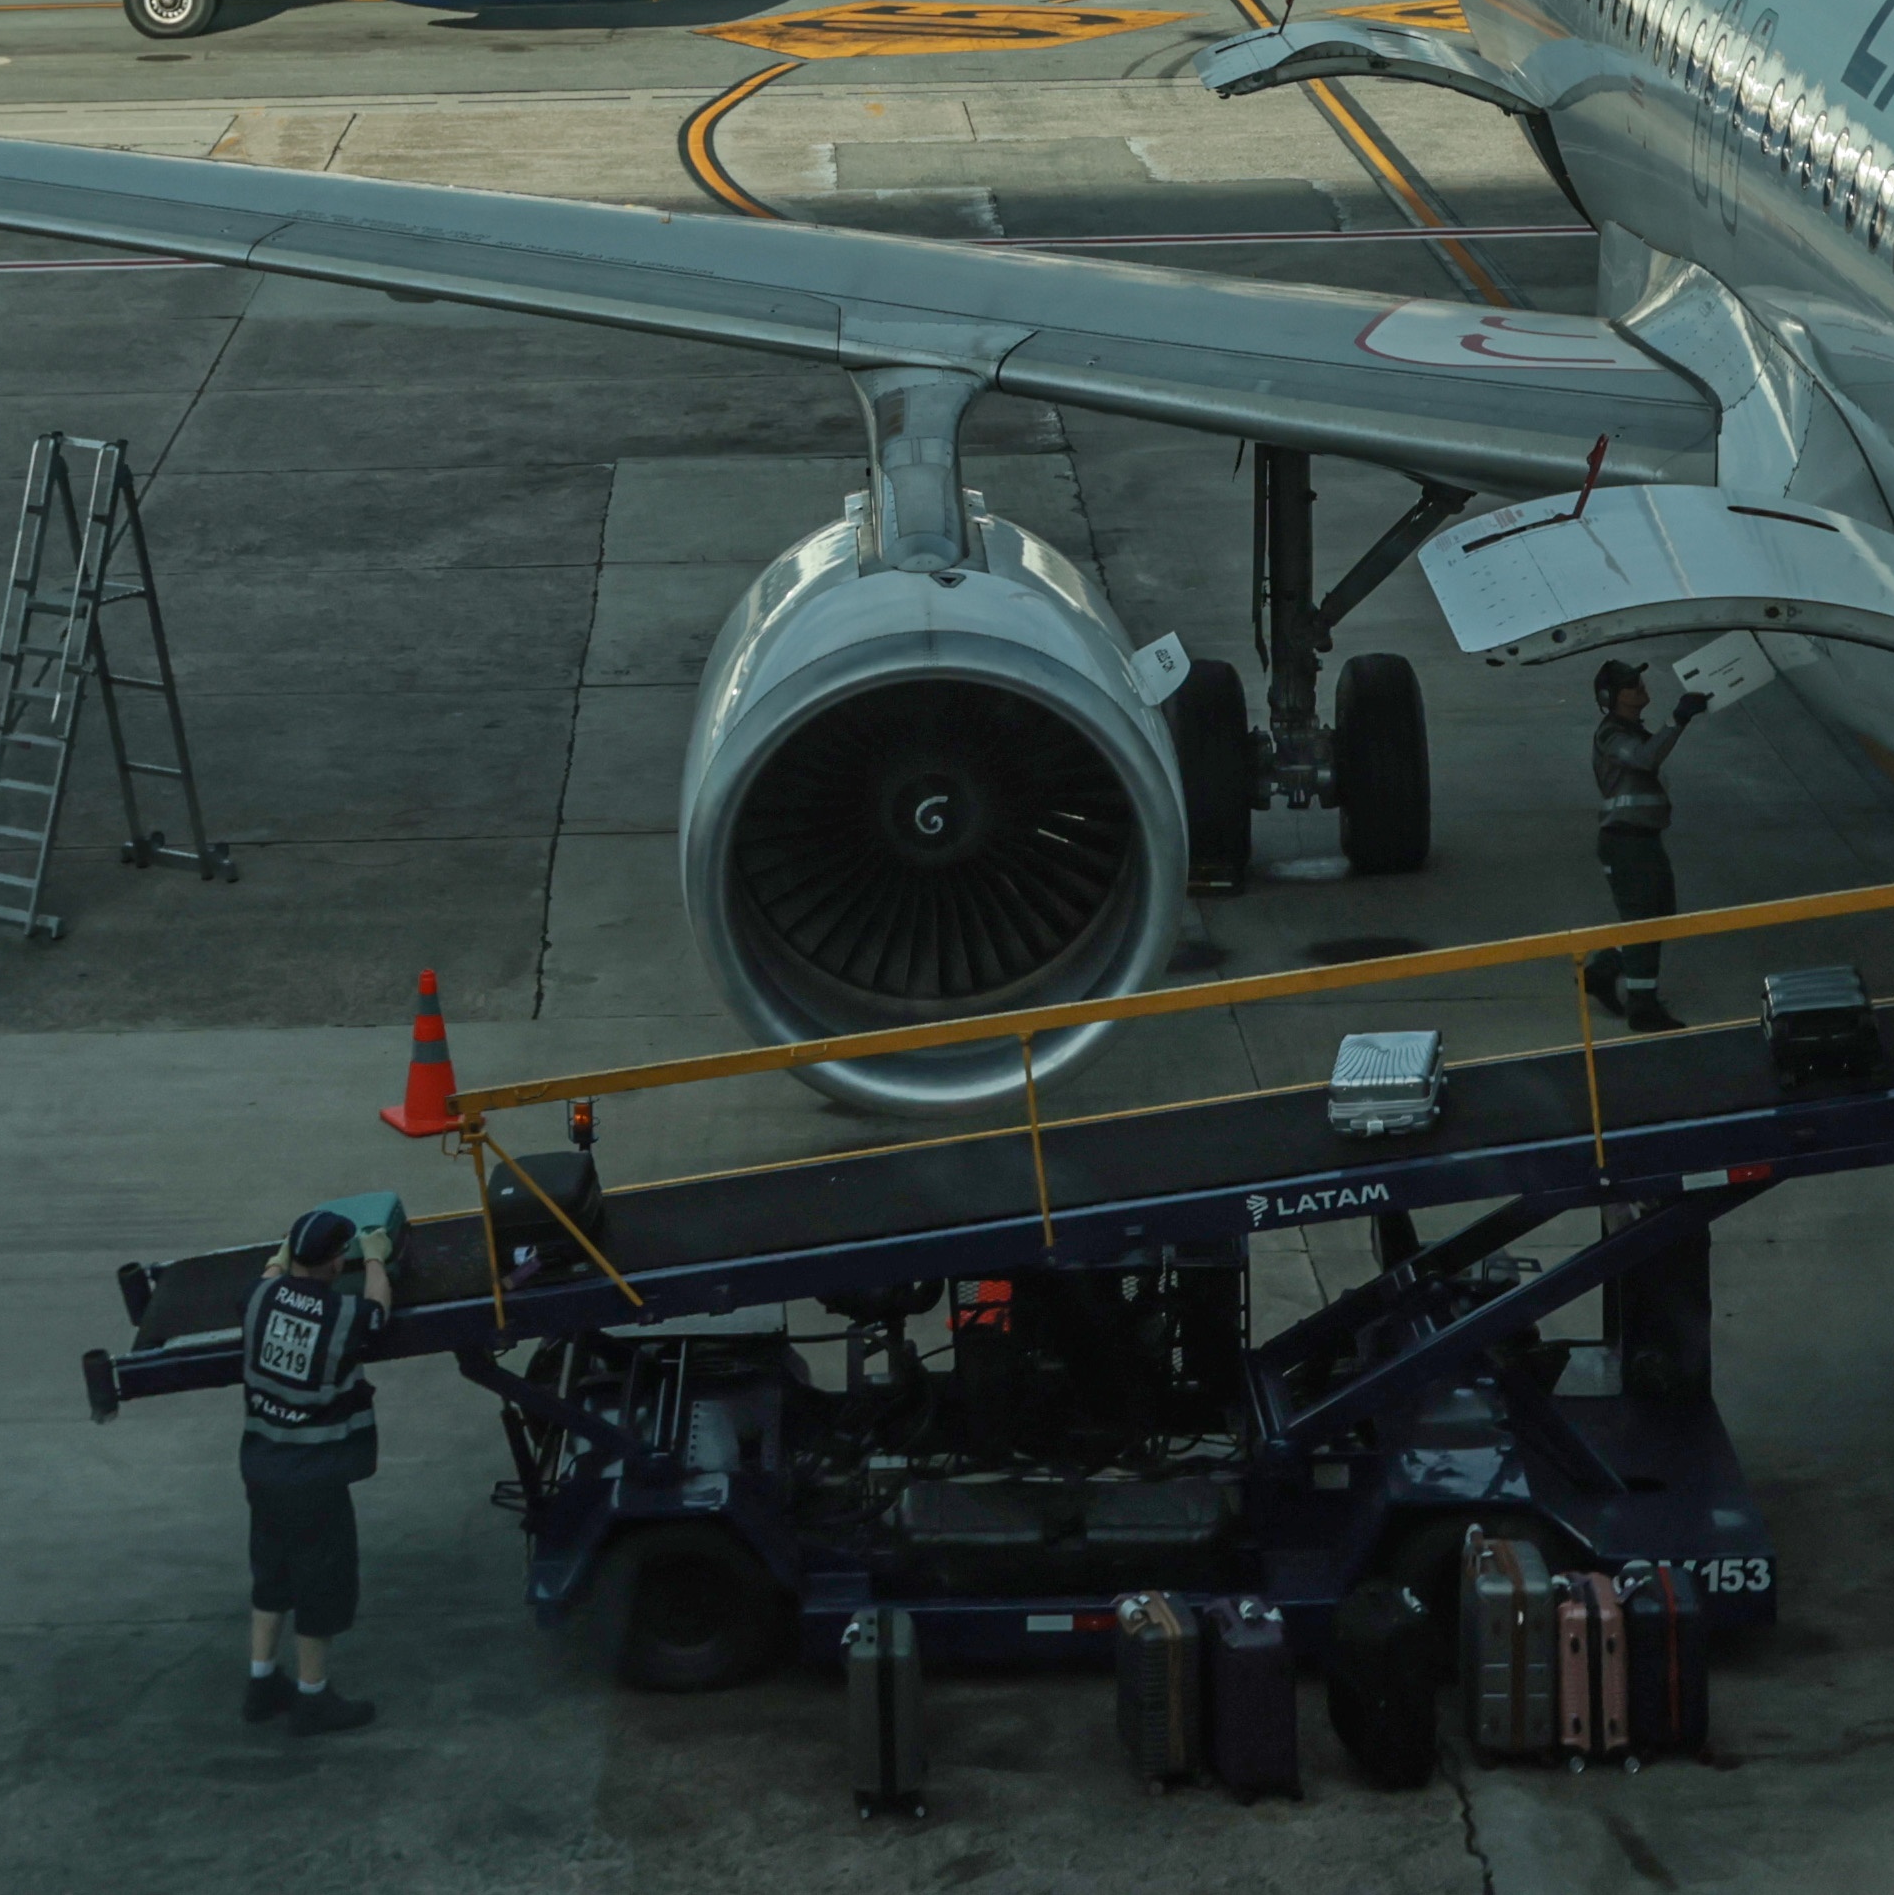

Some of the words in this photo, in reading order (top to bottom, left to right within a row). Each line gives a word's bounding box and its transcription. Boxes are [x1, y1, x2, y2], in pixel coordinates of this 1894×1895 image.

[1276, 1184, 1390, 1216] LATAM
[275, 1286, 324, 1316] RAMPA
[270, 1315, 312, 1348] LTM
[263, 1342, 307, 1374] 0219
[1700, 1557, 1771, 1593] 153
